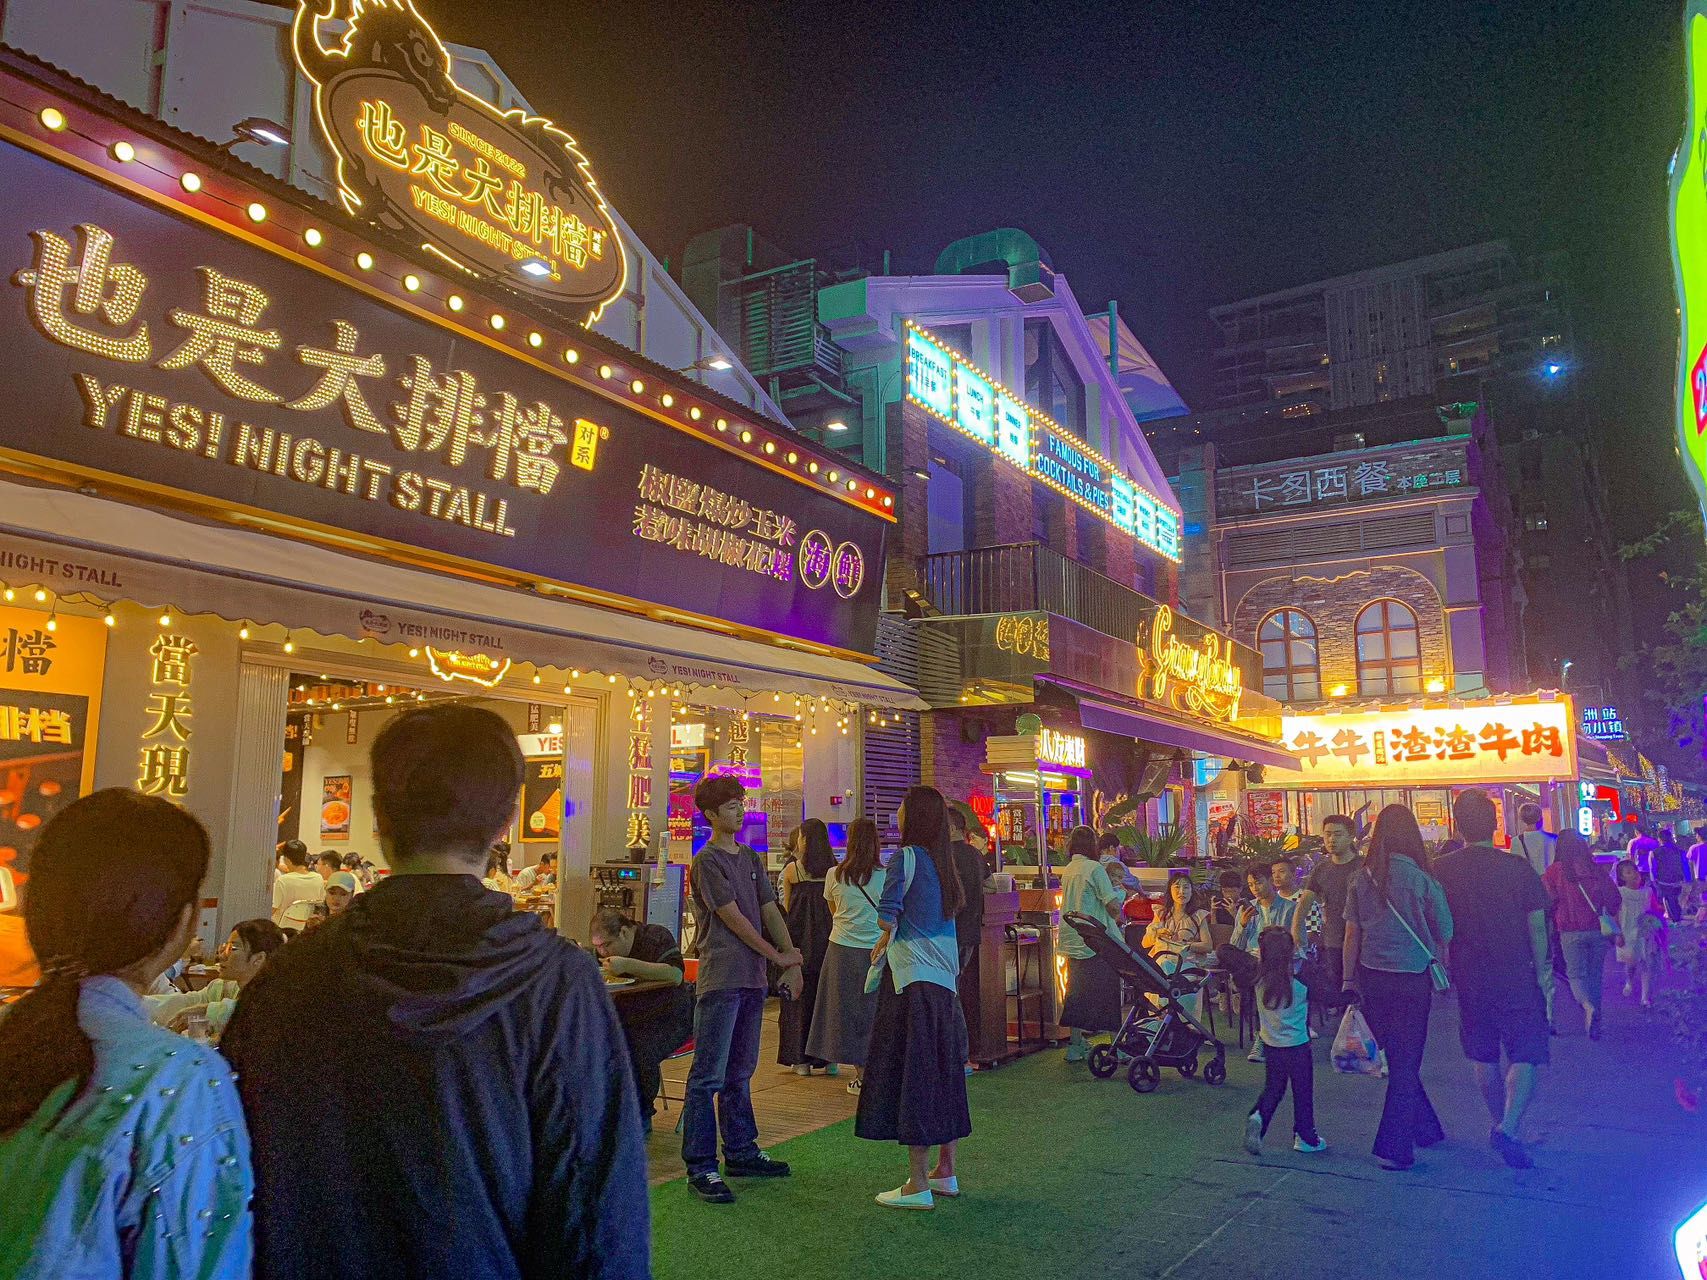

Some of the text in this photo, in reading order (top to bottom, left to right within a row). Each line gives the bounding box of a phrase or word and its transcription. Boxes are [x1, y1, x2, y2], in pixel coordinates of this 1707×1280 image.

[448, 122, 527, 177] SINCE 2022
[357, 99, 588, 269] 也是大排檔
[411, 185, 457, 225] YES!
[458, 211, 513, 252] NIGHT
[12, 222, 568, 497] 也是大排檔
[911, 347, 948, 380] BREAKFAST
[966, 384, 984, 404] LUNCH
[78, 372, 517, 538] YES! NIGHT STALL
[574, 423, 599, 467] 对系
[1048, 434, 1100, 482] FAMOUS FOR
[1037, 452, 1084, 497] COCKTAILS
[1084, 482, 1093, 501] &
[1092, 486, 1109, 510] PIES
[1242, 460, 1390, 510] 卡图西餐
[62, 563, 122, 588] STALL
[398, 622, 427, 639] YES!
[430, 626, 468, 645] NIGHT
[470, 633, 504, 650] STALL
[672, 664, 741, 684] YES! NIGHT STALL
[1390, 722, 1563, 763] 渣渣牛肉
